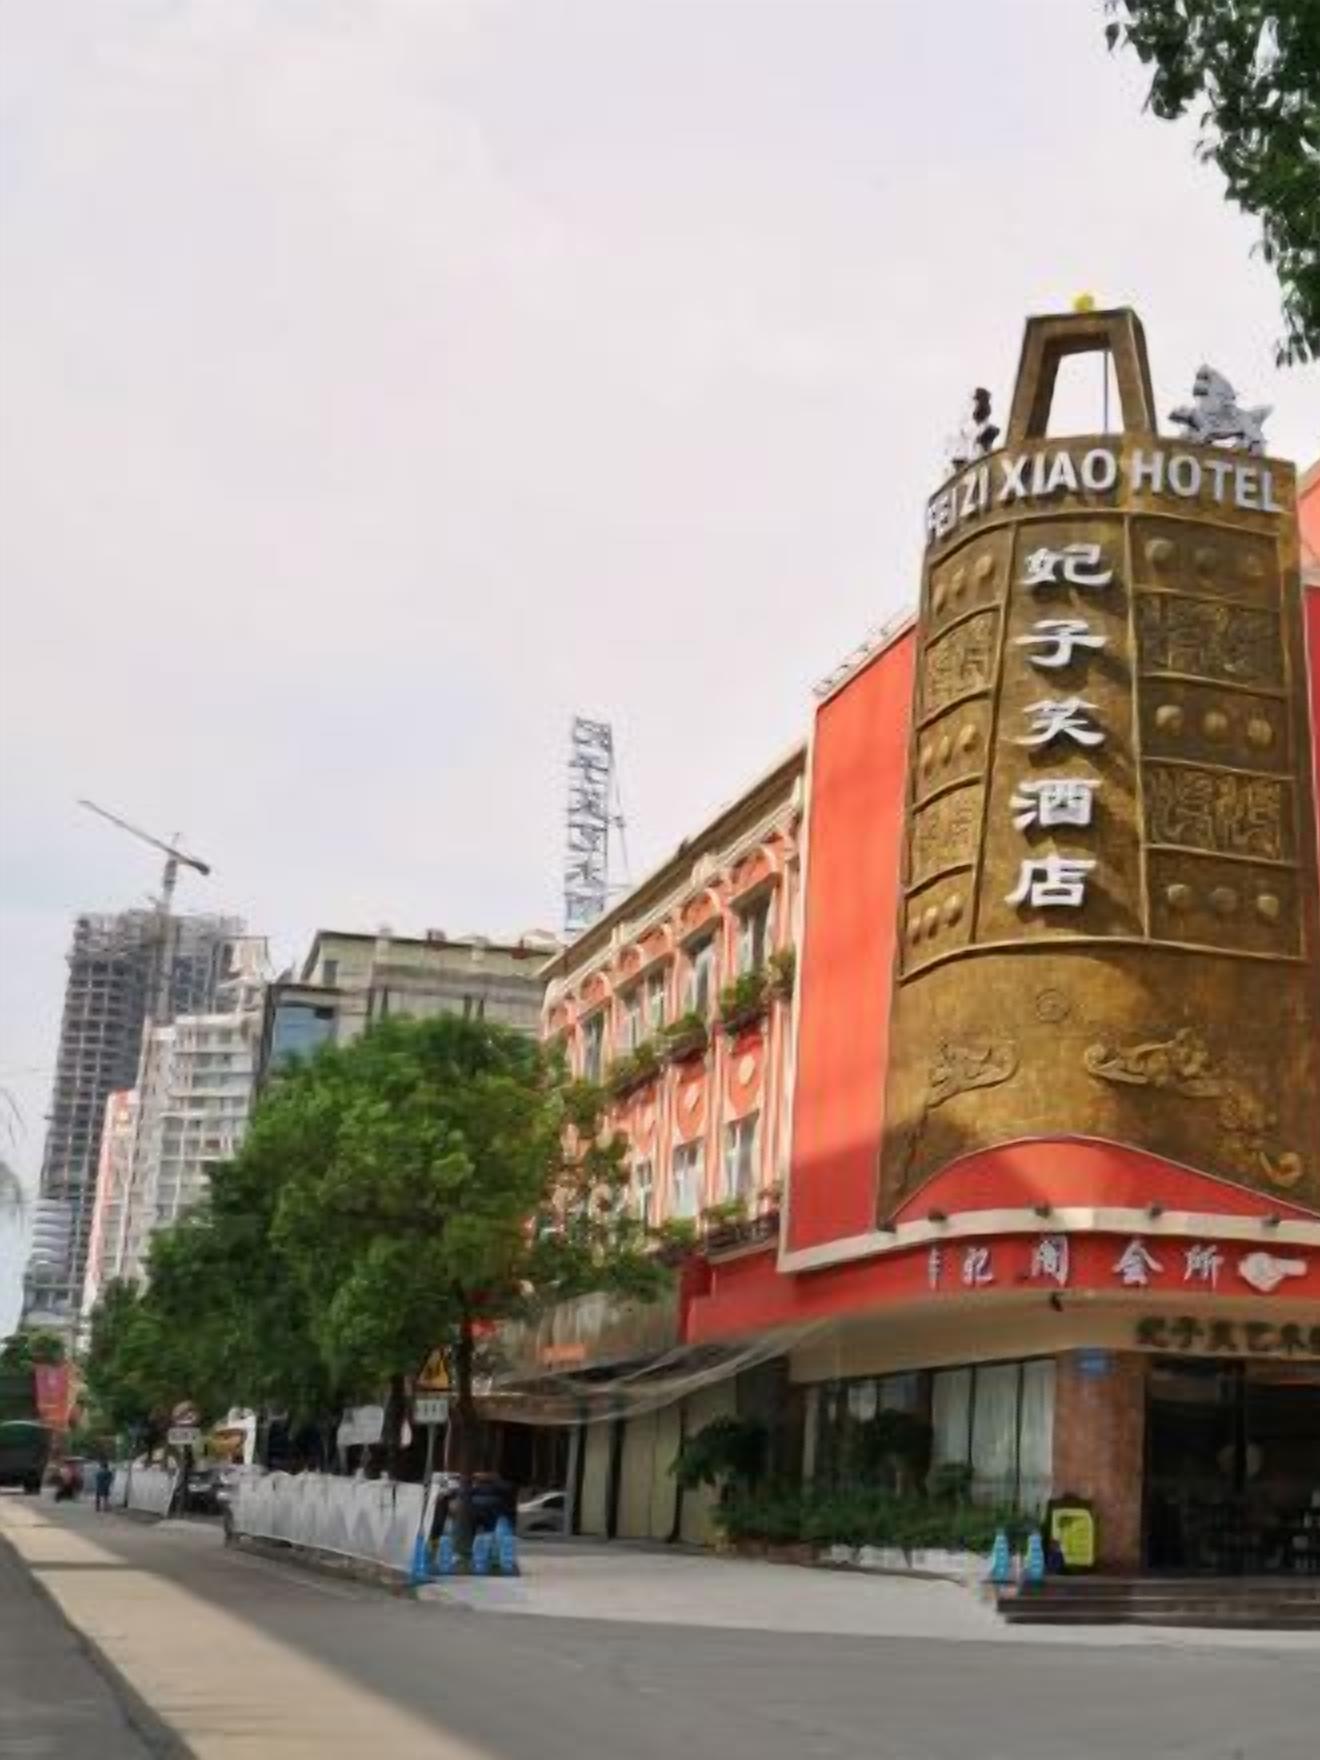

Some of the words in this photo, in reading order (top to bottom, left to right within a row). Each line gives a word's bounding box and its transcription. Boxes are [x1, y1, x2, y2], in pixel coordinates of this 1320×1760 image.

[999, 448, 1116, 500] XIAO
[1132, 450, 1284, 513] HOTEL
[1005, 543, 1112, 907] 妃子笑酒店
